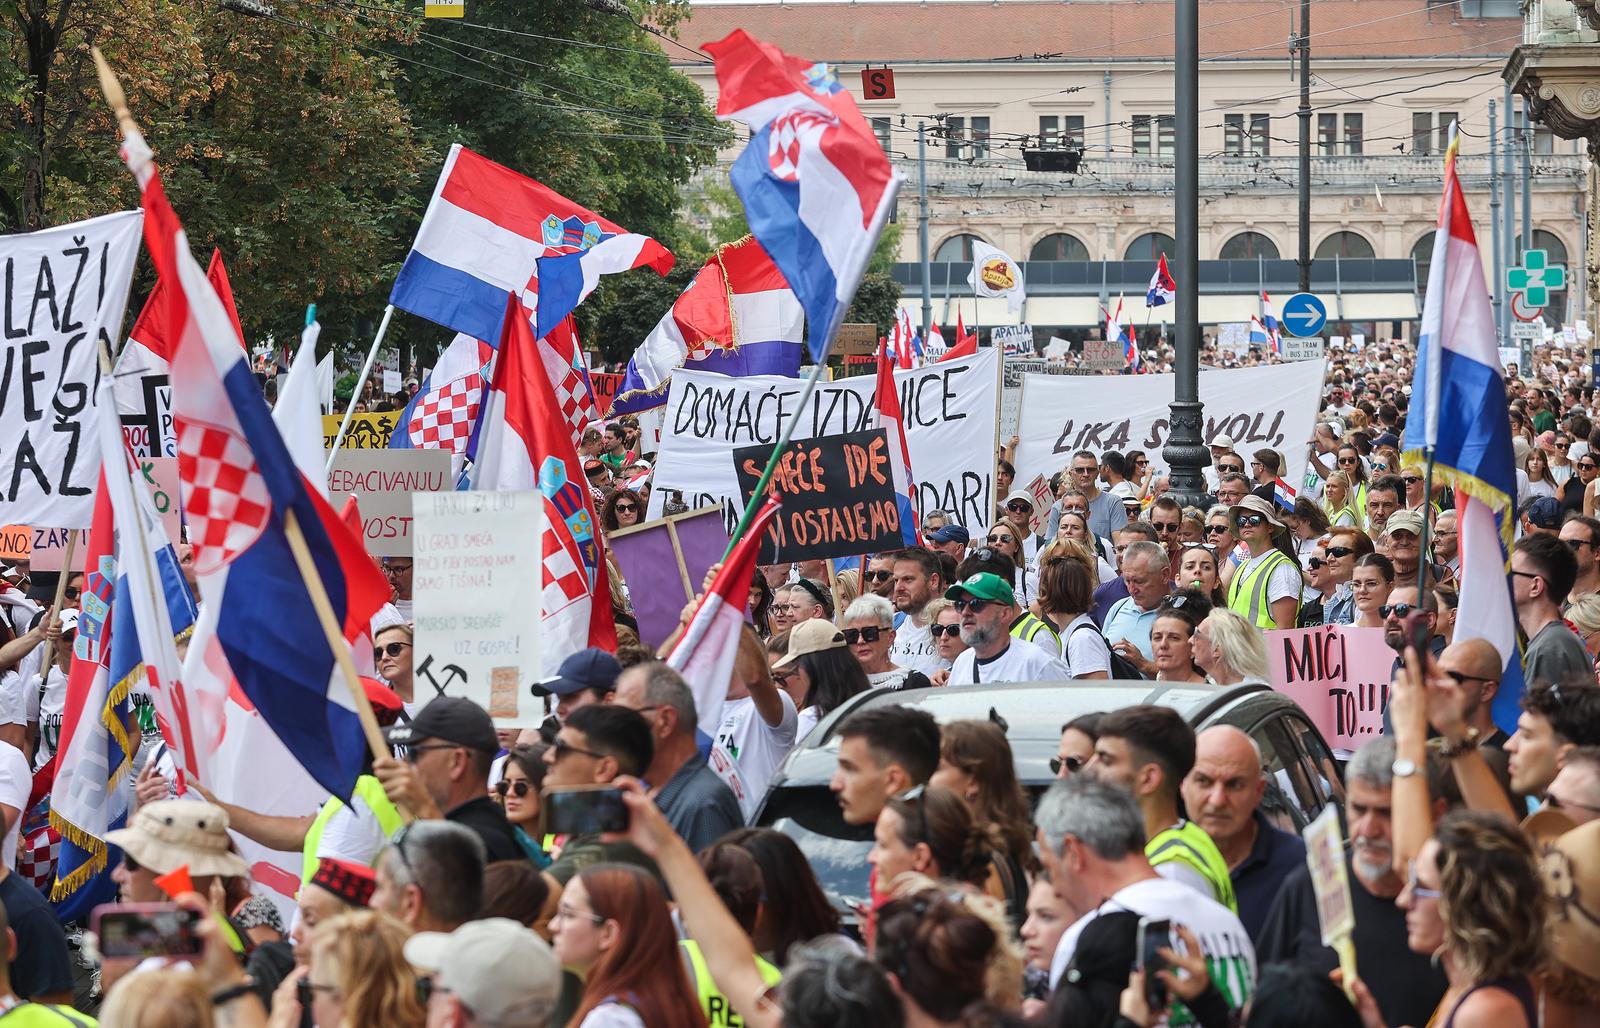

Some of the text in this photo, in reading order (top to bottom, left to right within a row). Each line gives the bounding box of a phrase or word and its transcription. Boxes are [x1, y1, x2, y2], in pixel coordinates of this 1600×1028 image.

[871, 72, 887, 97] S
[1052, 418, 1130, 455] LIKA
[843, 436, 887, 488] IDE
[791, 501, 899, 547] OSTAJEMO
[1283, 625, 1348, 684] MIČI
